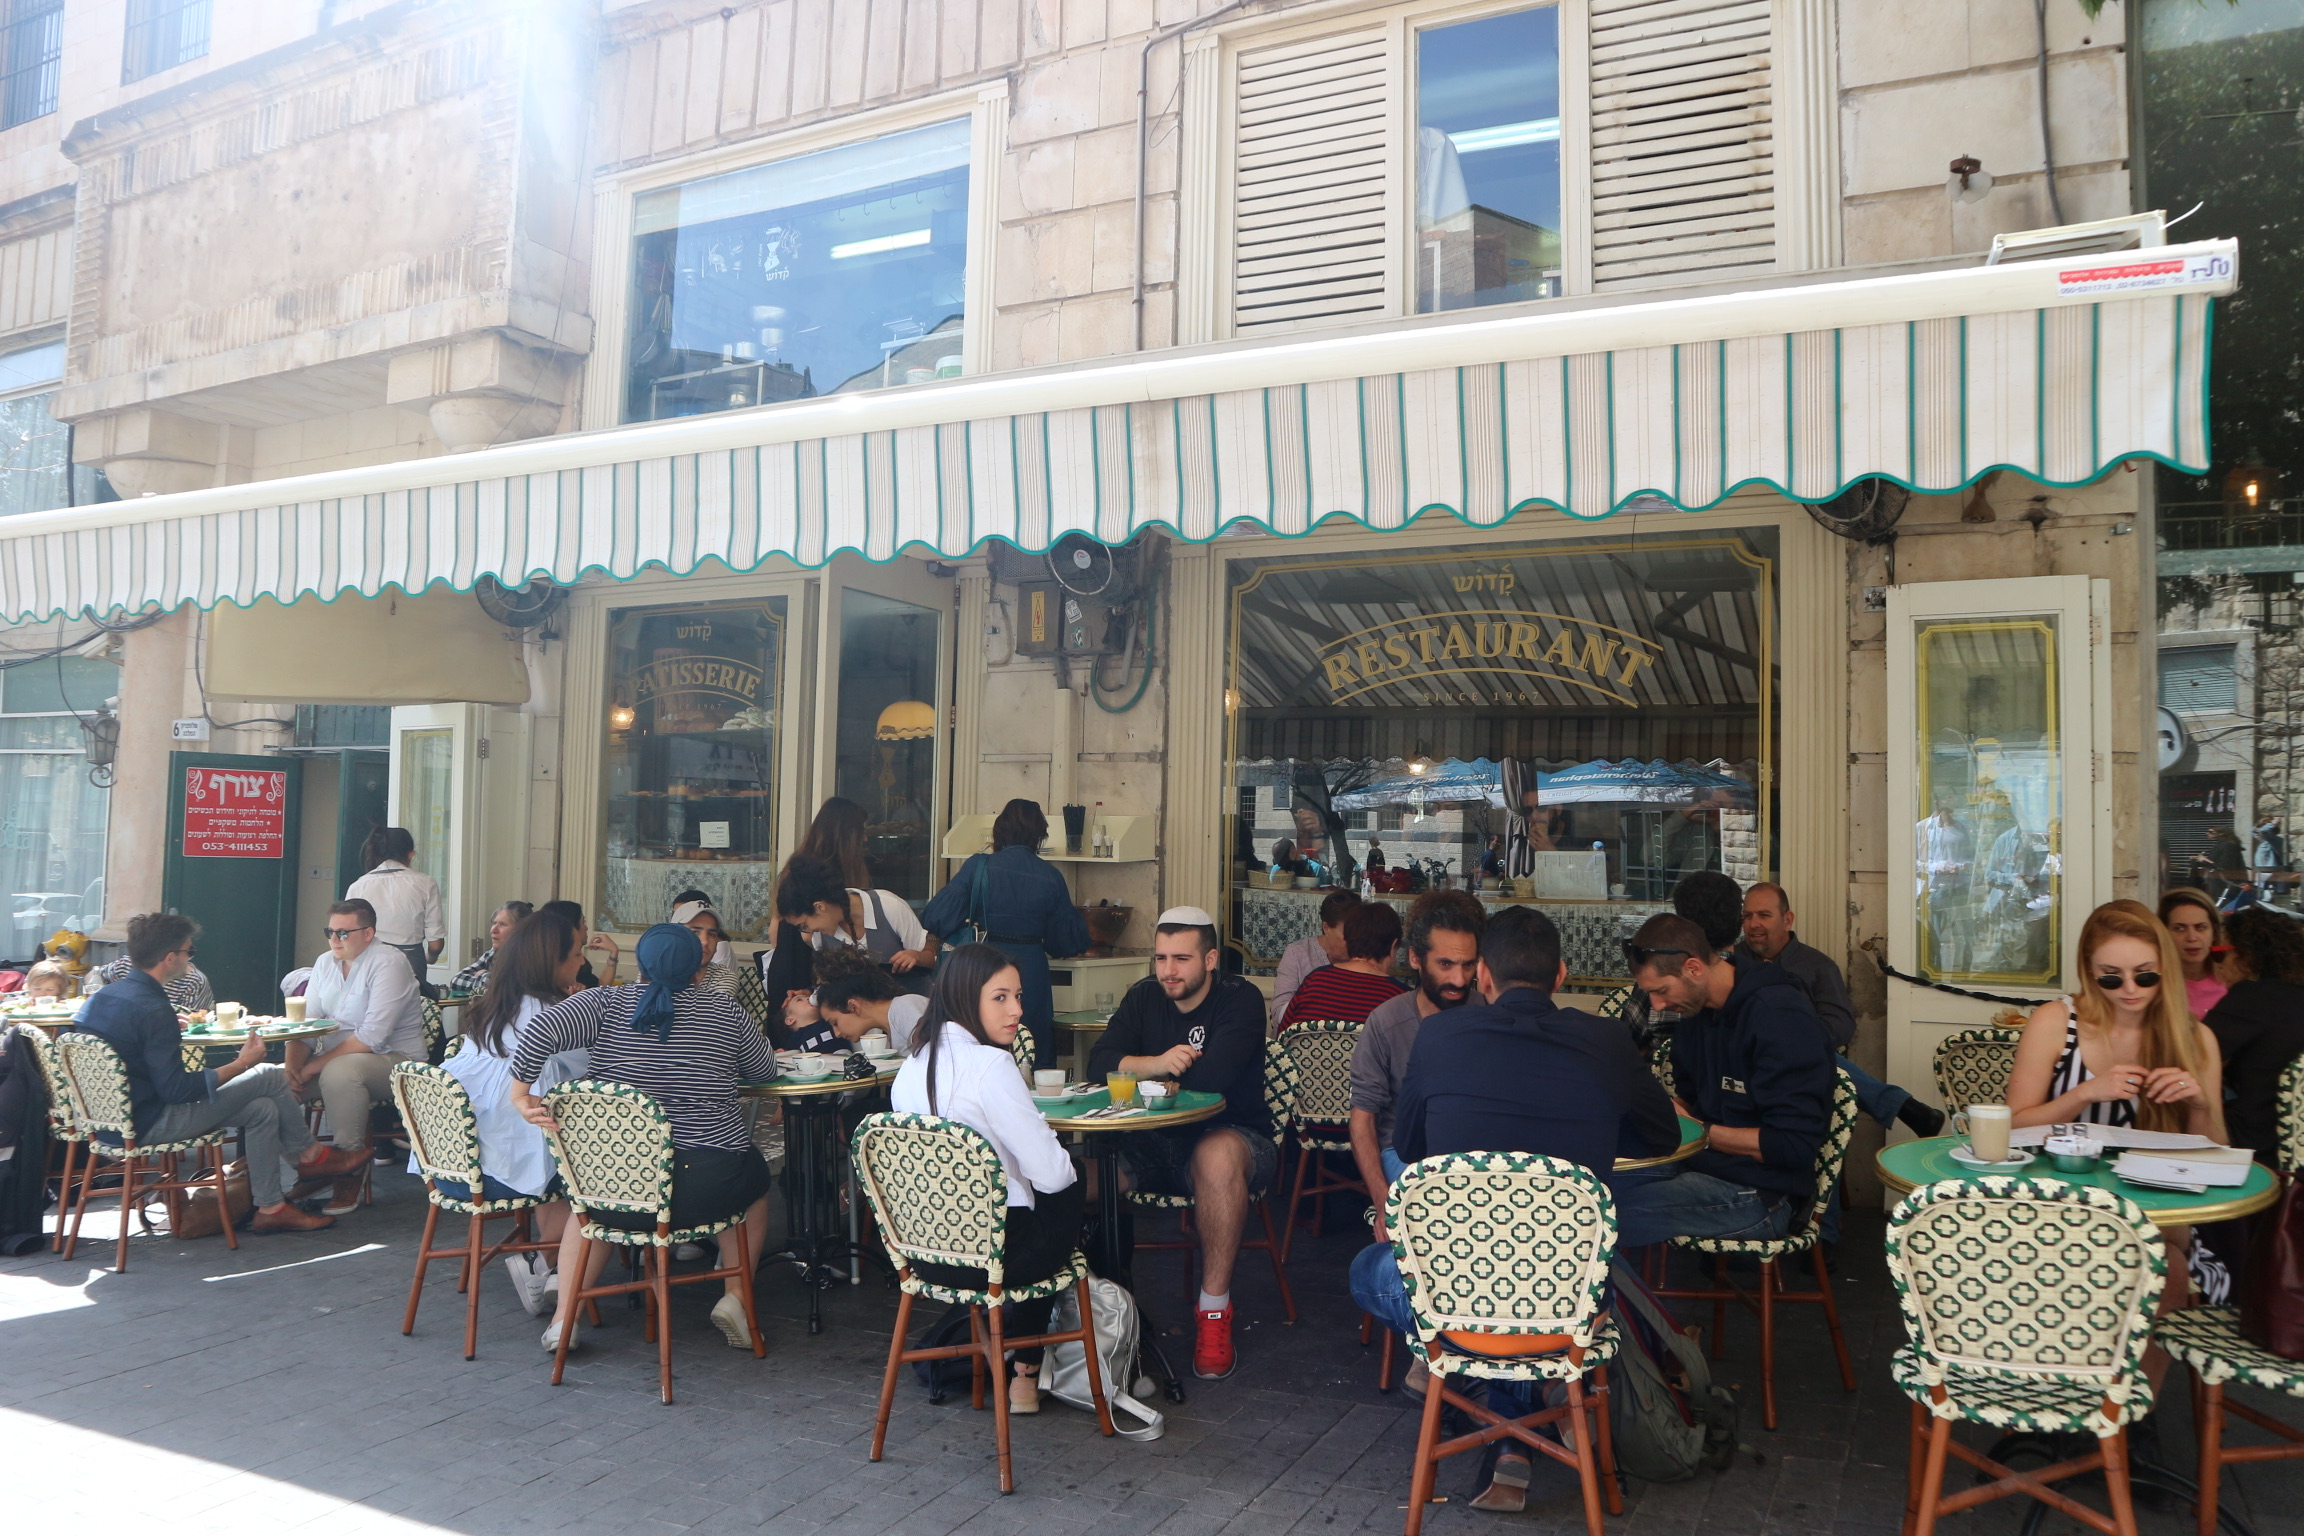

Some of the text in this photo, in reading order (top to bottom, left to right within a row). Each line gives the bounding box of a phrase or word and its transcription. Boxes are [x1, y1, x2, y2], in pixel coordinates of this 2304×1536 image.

[1321, 621, 1655, 692] RESTAURANT
[630, 662, 761, 699] PATISSERIE
[1423, 691, 1541, 702] SINCE 1967
[173, 722, 180, 737] 6
[208, 773, 265, 805] צורף
[208, 816, 264, 828] הלחמות משקפיים
[258, 829, 278, 839] החלפת
[202, 842, 268, 851] 053-4111453
